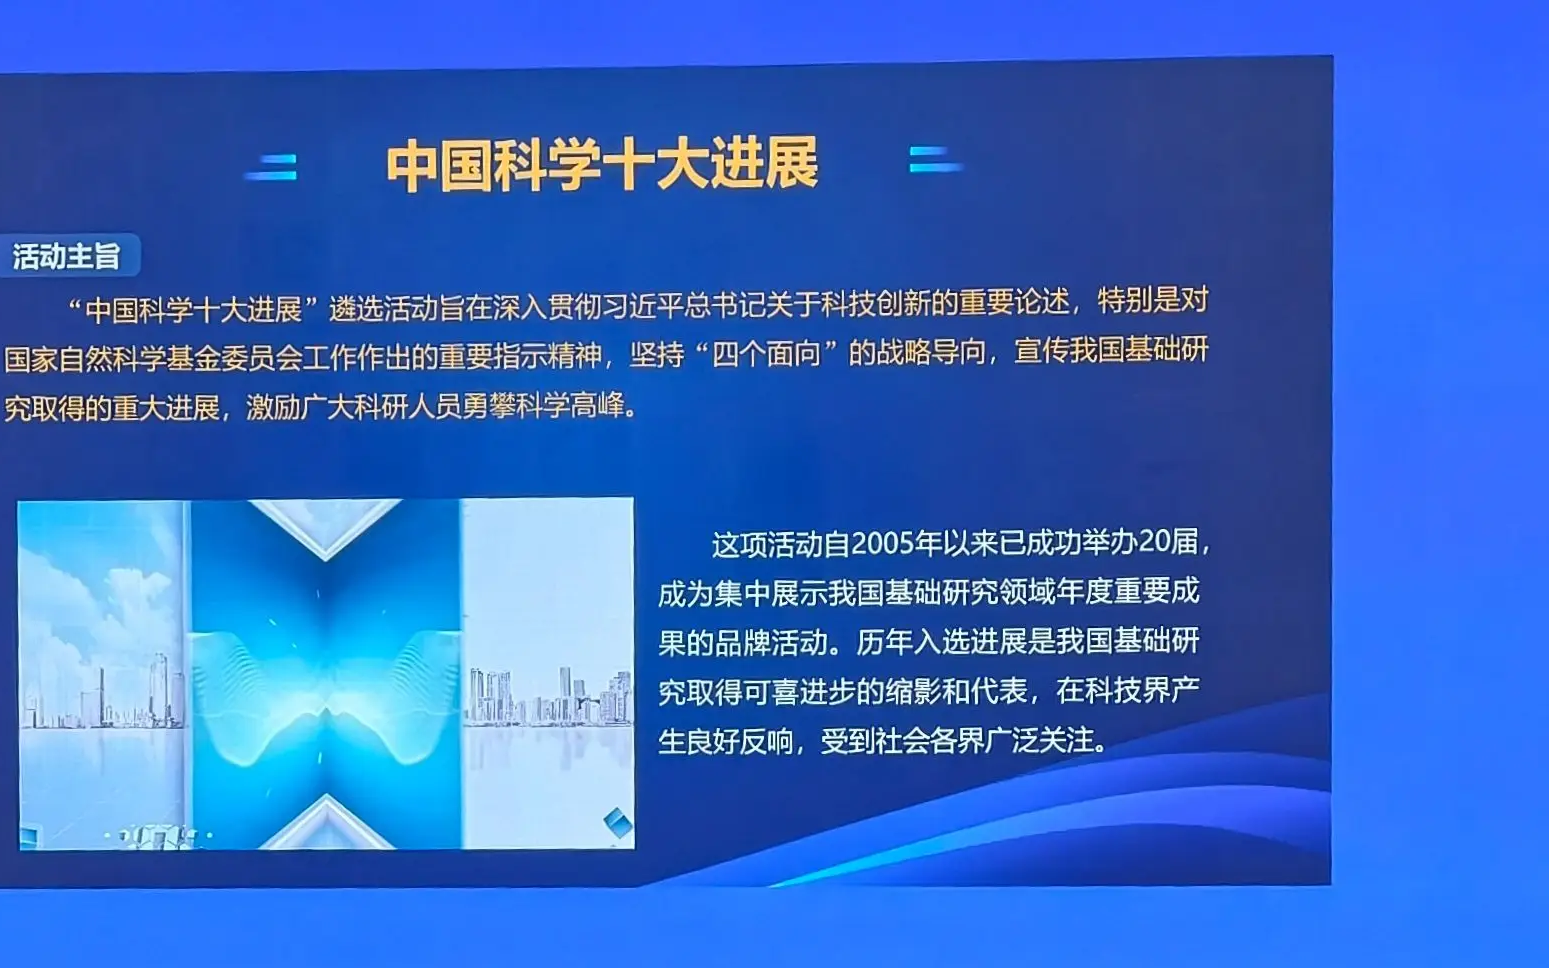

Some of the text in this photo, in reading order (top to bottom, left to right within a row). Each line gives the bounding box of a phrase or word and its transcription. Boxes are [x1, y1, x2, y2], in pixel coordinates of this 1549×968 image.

[387, 134, 819, 193] 中国科学十大进展
[13, 242, 120, 271] 活动主旨
[4, 390, 635, 422] 究取得的重大进展，激励广大科研人员勇攀科学高峰。
[712, 527, 1209, 559] 这项活动自2005年以来已成功举办20届，
[658, 575, 1200, 608] 成为集中展示我国基础研究领域年度重要成
[659, 625, 1200, 657] 果的品牌活动。历年入选进展是我国基础研
[659, 675, 1200, 706] 究取得可喜进步的缩影和代表，在科技界产
[658, 725, 1105, 755] 生良好反响，受到社会各界广泛关注。
